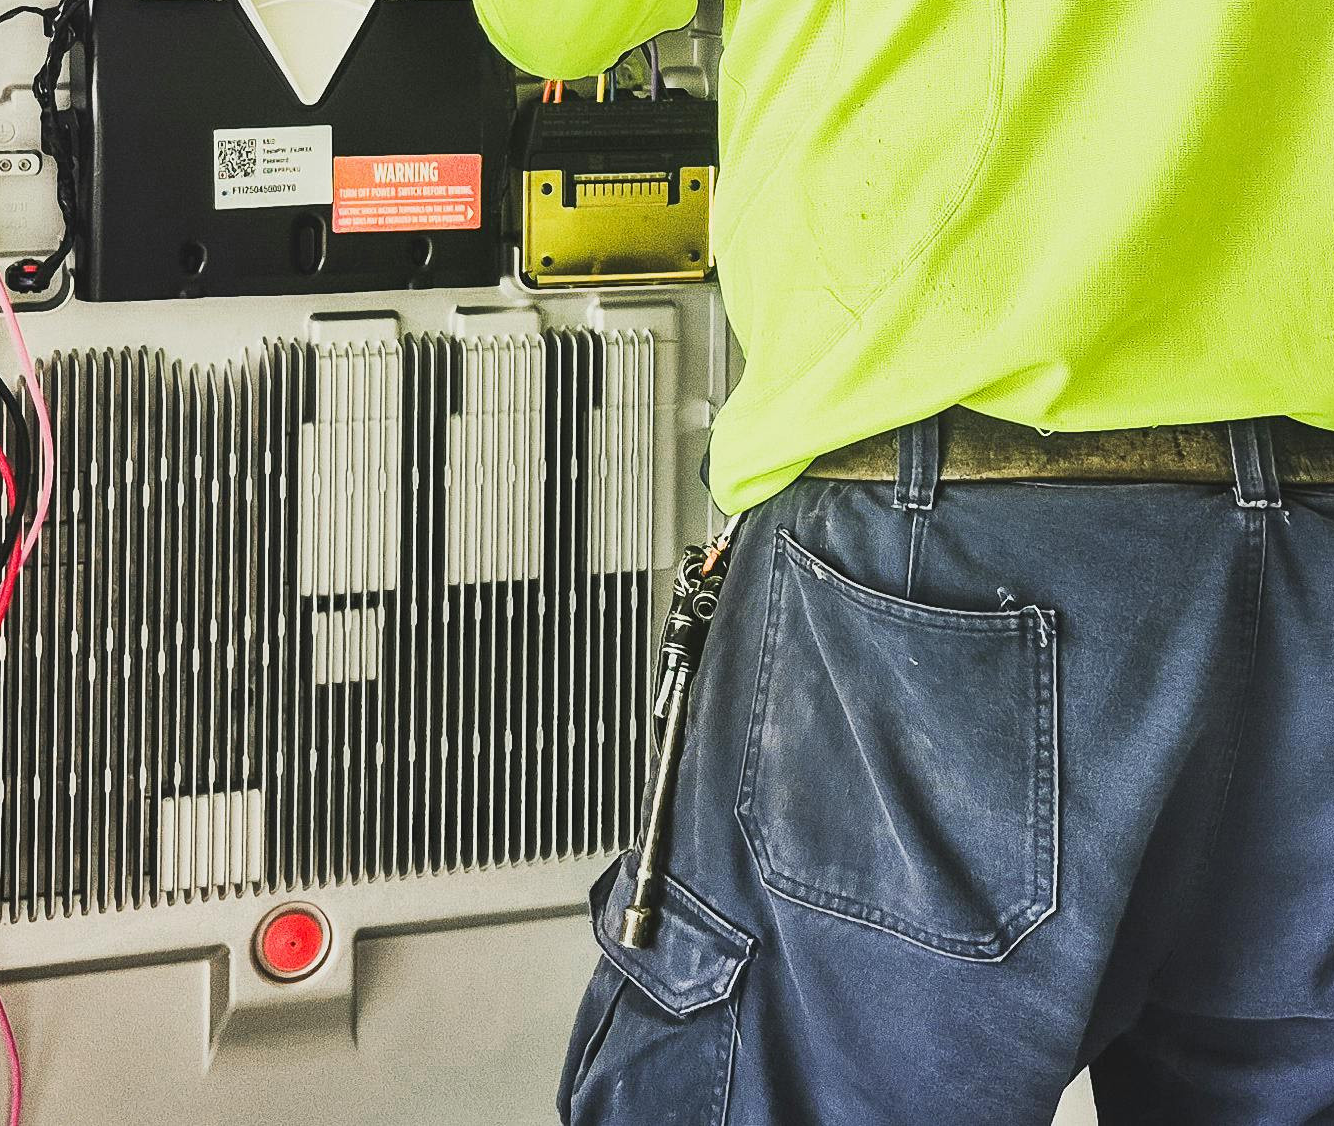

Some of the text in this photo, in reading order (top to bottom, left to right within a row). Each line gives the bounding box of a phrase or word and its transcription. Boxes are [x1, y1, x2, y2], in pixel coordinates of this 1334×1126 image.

[373, 161, 439, 184] WARNING
[339, 188, 357, 199] TURN
[358, 187, 370, 198] OFF
[371, 187, 396, 198] POWER
[397, 186, 422, 197] SWITCH
[422, 186, 447, 197] BEFORE
